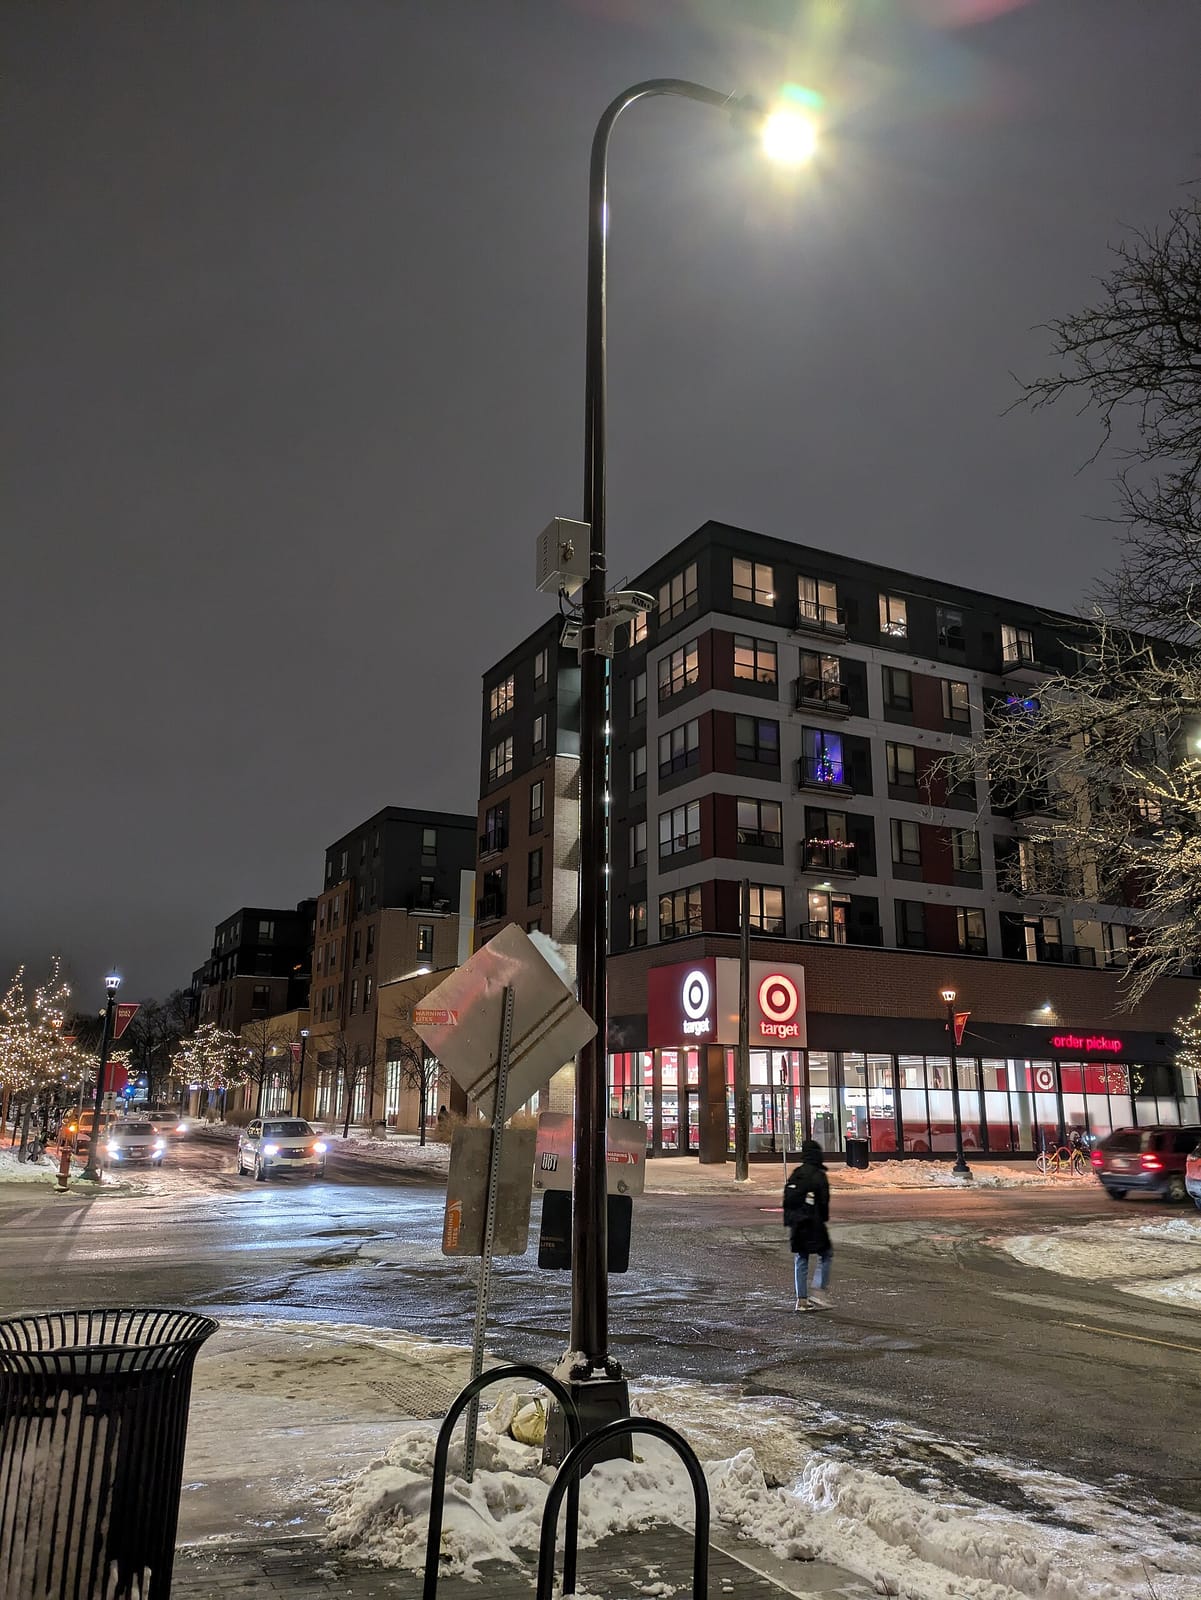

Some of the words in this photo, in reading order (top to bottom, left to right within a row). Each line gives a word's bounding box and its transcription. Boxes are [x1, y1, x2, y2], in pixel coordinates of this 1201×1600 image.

[683, 1018, 710, 1036] target
[760, 1021, 799, 1039] target
[1053, 1035, 1084, 1049] order
[1086, 1036, 1123, 1053] pickup
